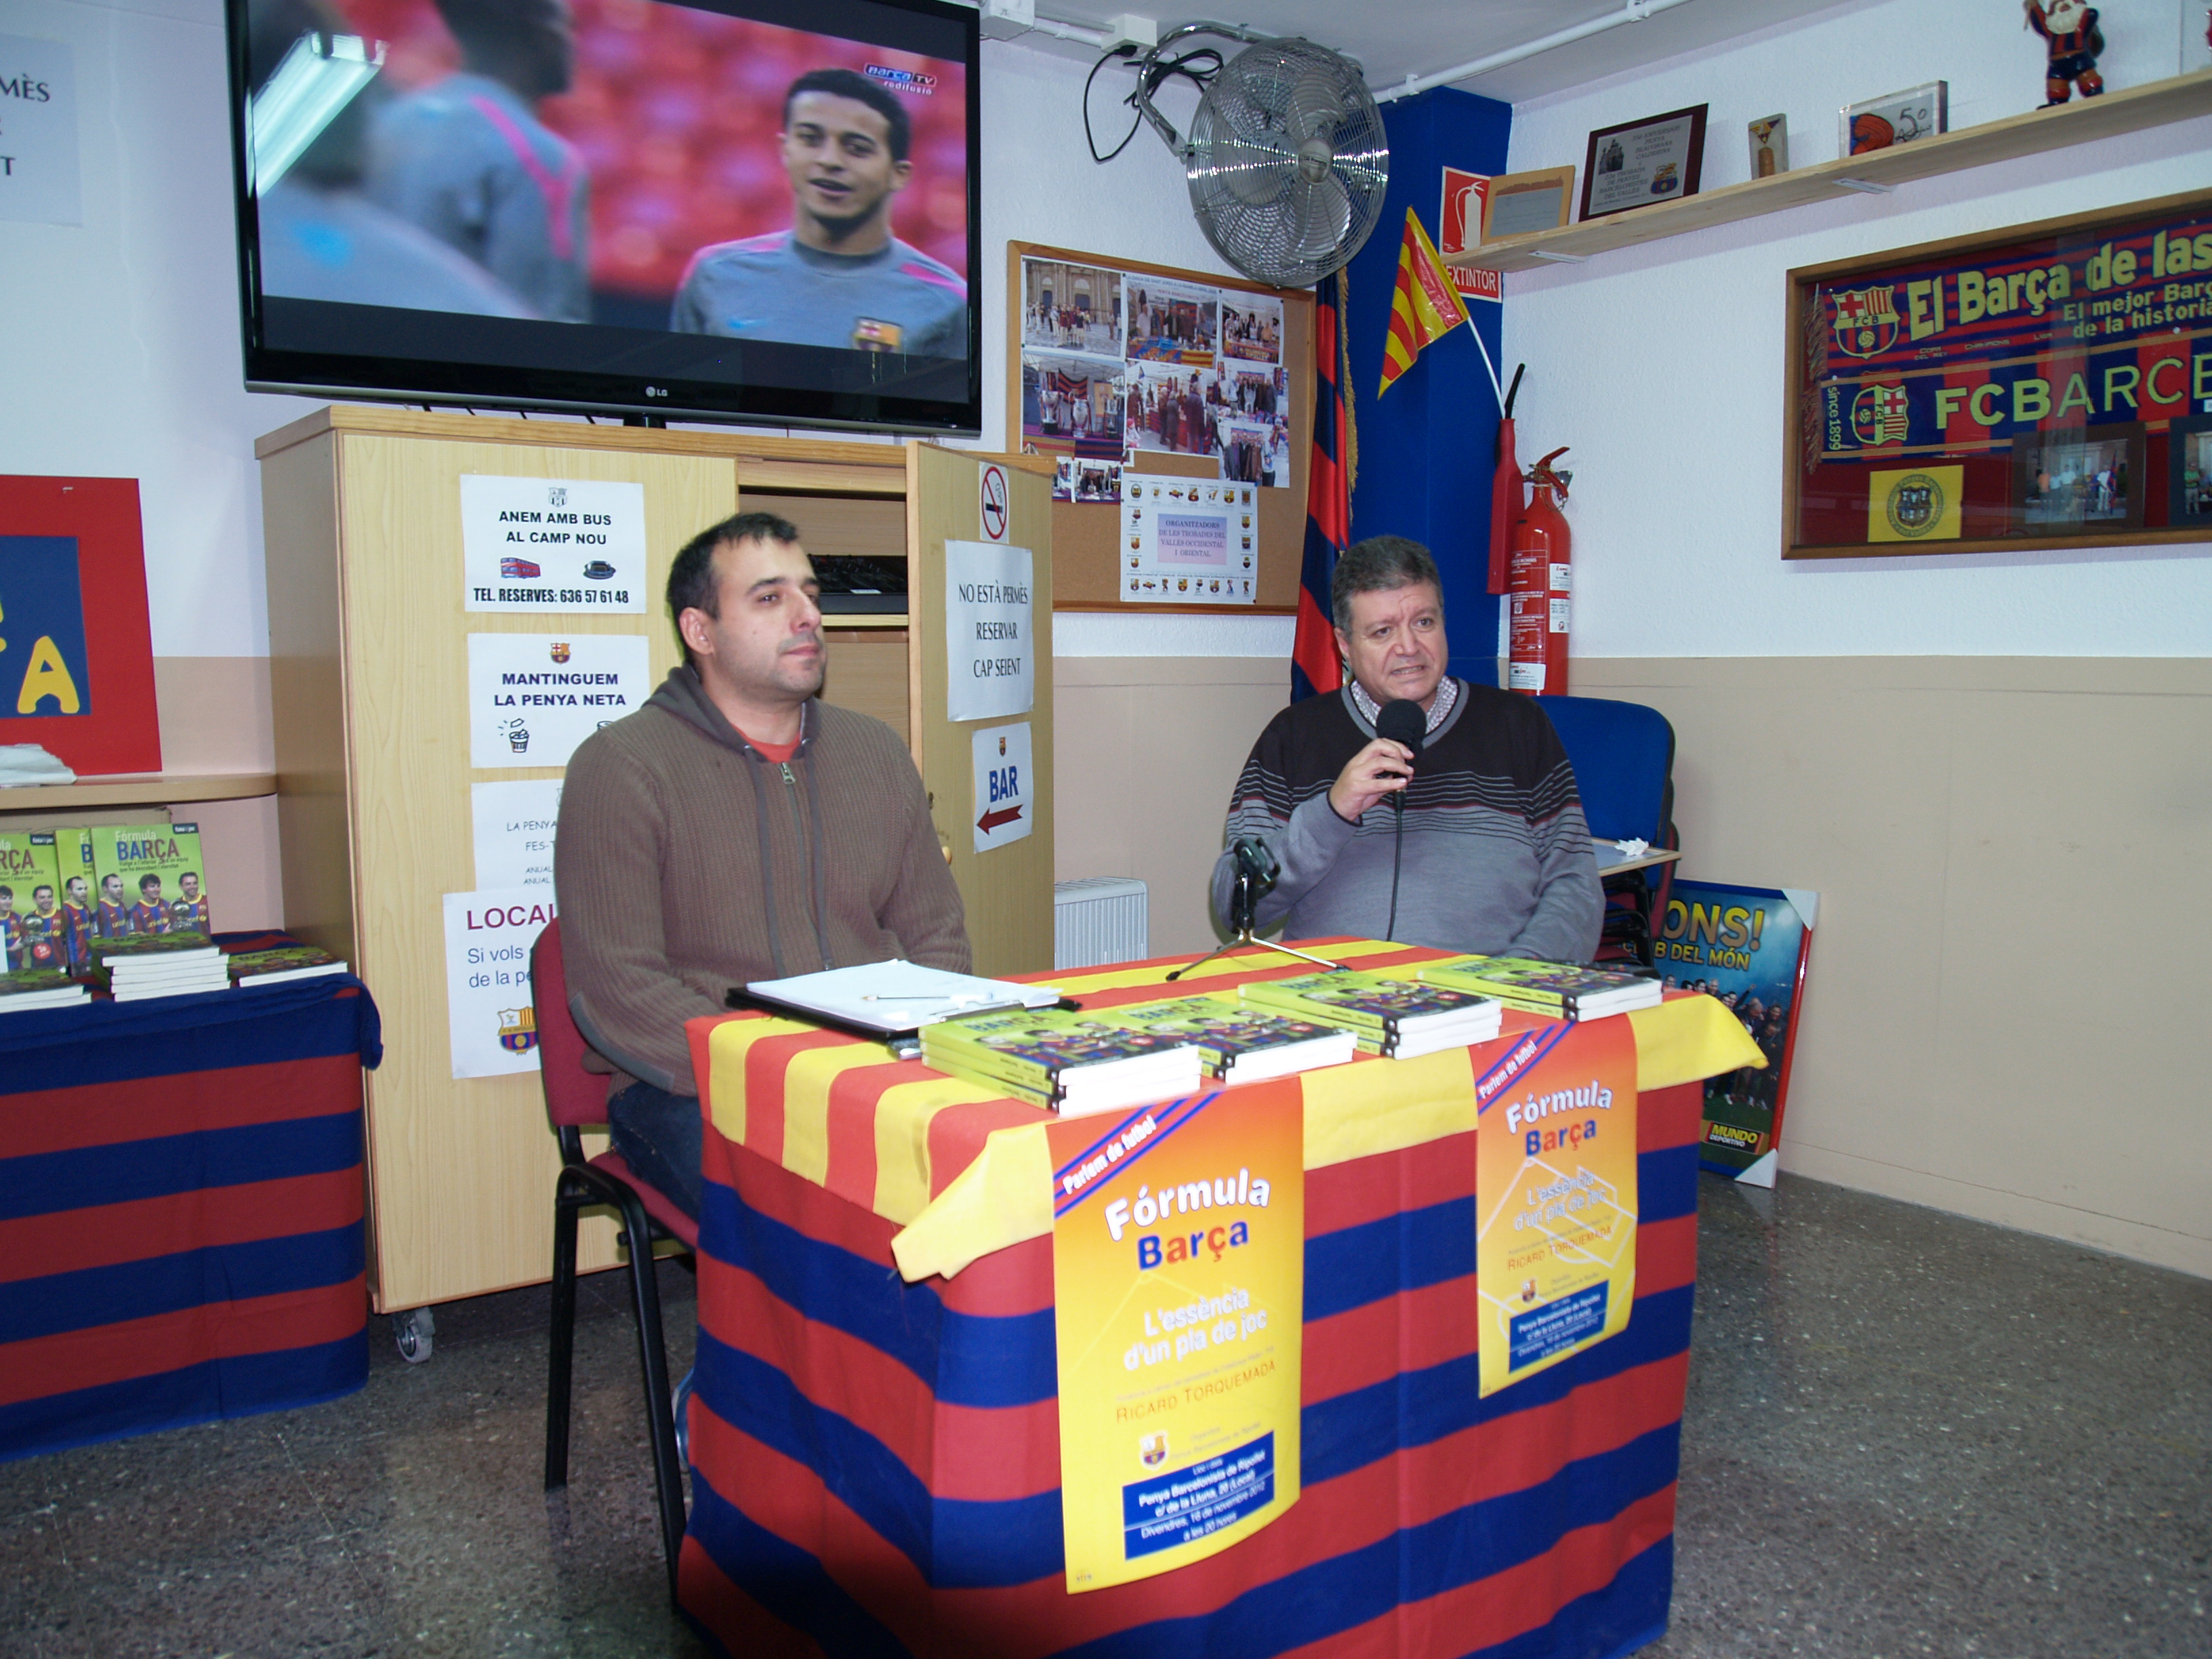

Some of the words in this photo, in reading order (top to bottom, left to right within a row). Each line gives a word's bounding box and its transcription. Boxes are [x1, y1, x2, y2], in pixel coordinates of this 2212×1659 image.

[916, 75, 934, 84] TV
[1907, 276, 1944, 342] El
[1958, 264, 2071, 325] Barça
[2085, 242, 2137, 291] de
[2152, 230, 2212, 279] las
[2064, 302, 2085, 321] El
[2092, 291, 2155, 316] mejor
[1853, 316, 1879, 327] FCB
[2072, 321, 2097, 338] de
[2105, 316, 2124, 333] la
[656, 388, 668, 397] LG
[1828, 386, 1840, 417] since
[1829, 419, 1841, 451] 1899
[499, 510, 541, 523] ANEM
[546, 512, 578, 525] AMB
[583, 514, 612, 525] BUS
[1165, 520, 1220, 529] ORGANITZADORS
[506, 531, 525, 542] AL
[529, 532, 571, 544] CAMP
[575, 533, 607, 544] NOU
[1181, 530, 1213, 538] TROBADES
[474, 588, 495, 602] TEL.
[499, 588, 557, 602] RESERVES:
[560, 589, 582, 603] 636
[584, 590, 597, 603] 57
[600, 590, 613, 603] 61
[615, 590, 629, 603] 48
[958, 583, 975, 602] NO
[977, 579, 1001, 604] ESTÀ
[1003, 581, 1028, 604] PERMÈS
[976, 621, 1017, 640] RESERVAR
[973, 659, 993, 678] CAP
[995, 657, 1021, 676] SEIENT
[501, 673, 618, 685] MANTINGUEM
[494, 695, 516, 706] LA
[522, 695, 577, 705] PENYA
[583, 695, 626, 705] NETA
[989, 765, 1019, 802] BAR
[115, 830, 157, 842] Fórmula
[506, 822, 520, 832] LA
[523, 821, 557, 830] PENYA
[81, 844, 93, 863] B
[116, 838, 180, 865] BARÇA
[523, 877, 551, 885] ANUAL
[1662, 899, 1765, 952] ONS!
[468, 947, 484, 964] Si
[489, 945, 524, 961] vols
[1670, 943, 1704, 964] DEL
[1708, 947, 1750, 970] MÓN
[469, 972, 490, 988] de
[495, 970, 510, 985] la
[1505, 1079, 1614, 1135] Fórmula
[1525, 1119, 1597, 1158] Barça
[1711, 1124, 1758, 1144] MUNDO
[1062, 1154, 1109, 1195] Parlem
[1106, 1142, 1124, 1162] de
[1121, 1114, 1157, 1150] futbol
[1104, 1167, 1271, 1242] Fórmula
[1546, 1202, 1566, 1225] pla
[1569, 1193, 1585, 1212] de
[1136, 1220, 1250, 1271] Barça
[1508, 1250, 1546, 1272] RICARD
[1548, 1225, 1614, 1258] TORQUEMADA
[1143, 1288, 1250, 1337] L'essència
[1123, 1338, 1171, 1370] d'un
[1176, 1326, 1208, 1361] pla
[1212, 1317, 1236, 1344] de
[1240, 1309, 1268, 1343] joc
[1116, 1395, 1178, 1424] RICARD
[1183, 1359, 1276, 1404] TORQUEMADA
